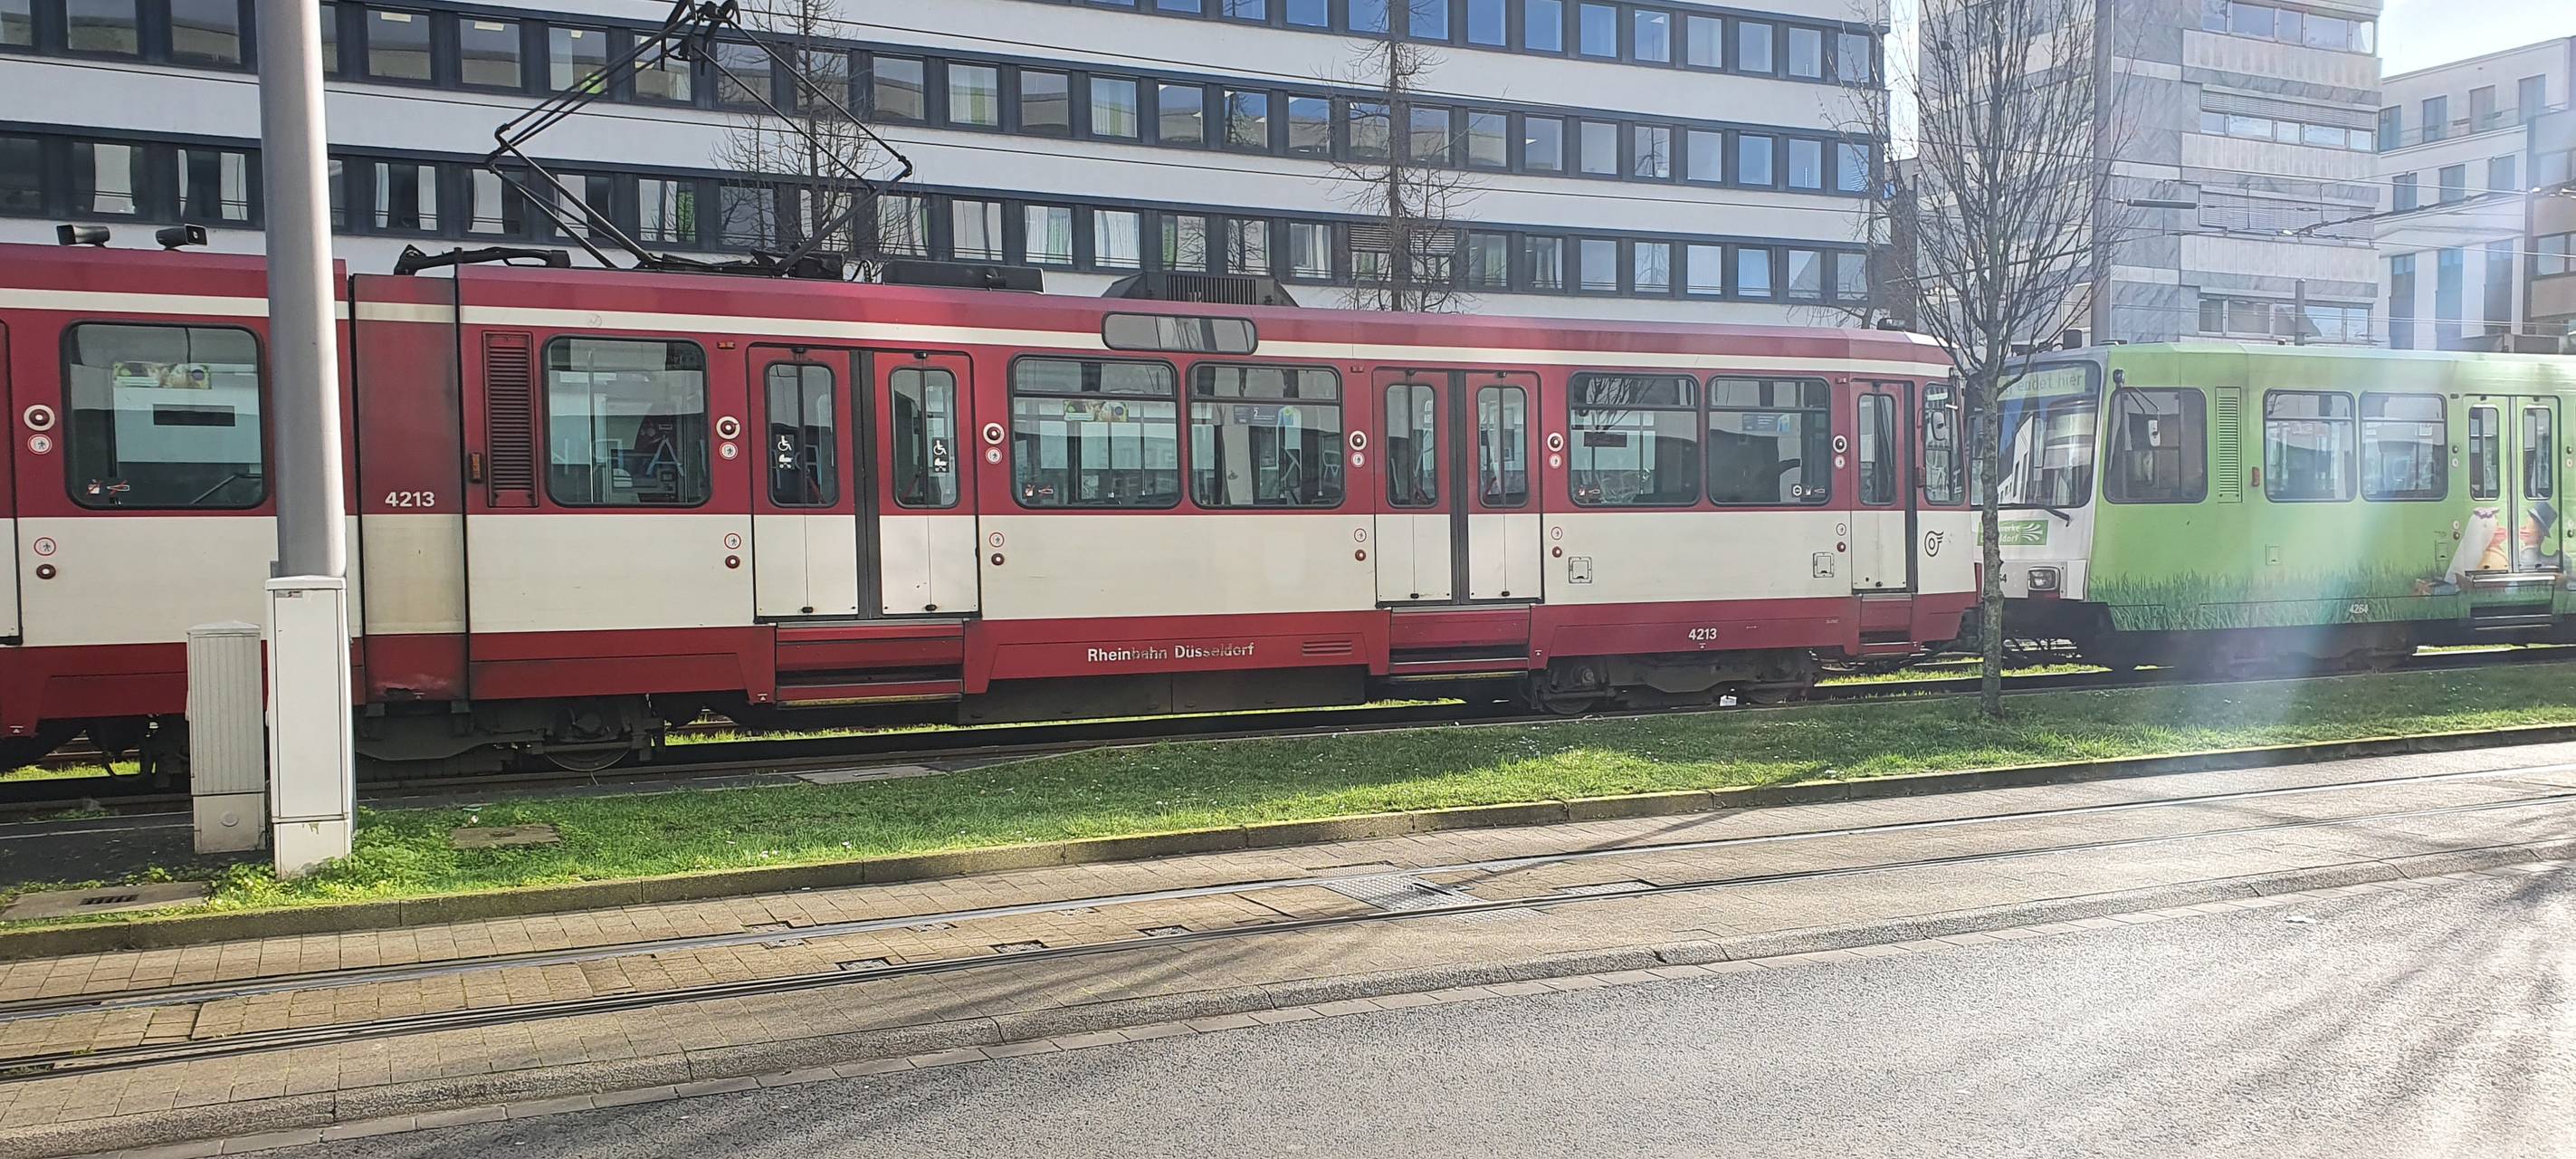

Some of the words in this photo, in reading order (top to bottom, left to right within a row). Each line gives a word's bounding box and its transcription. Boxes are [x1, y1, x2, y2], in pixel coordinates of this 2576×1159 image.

[2057, 372, 2083, 388] hier
[385, 491, 434, 507] 4213
[2349, 603, 2369, 614] 4264
[1688, 627, 1717, 640] 4213
[1087, 646, 1168, 662] Rheinbahn
[1174, 642, 1255, 658] Düsseldorf
